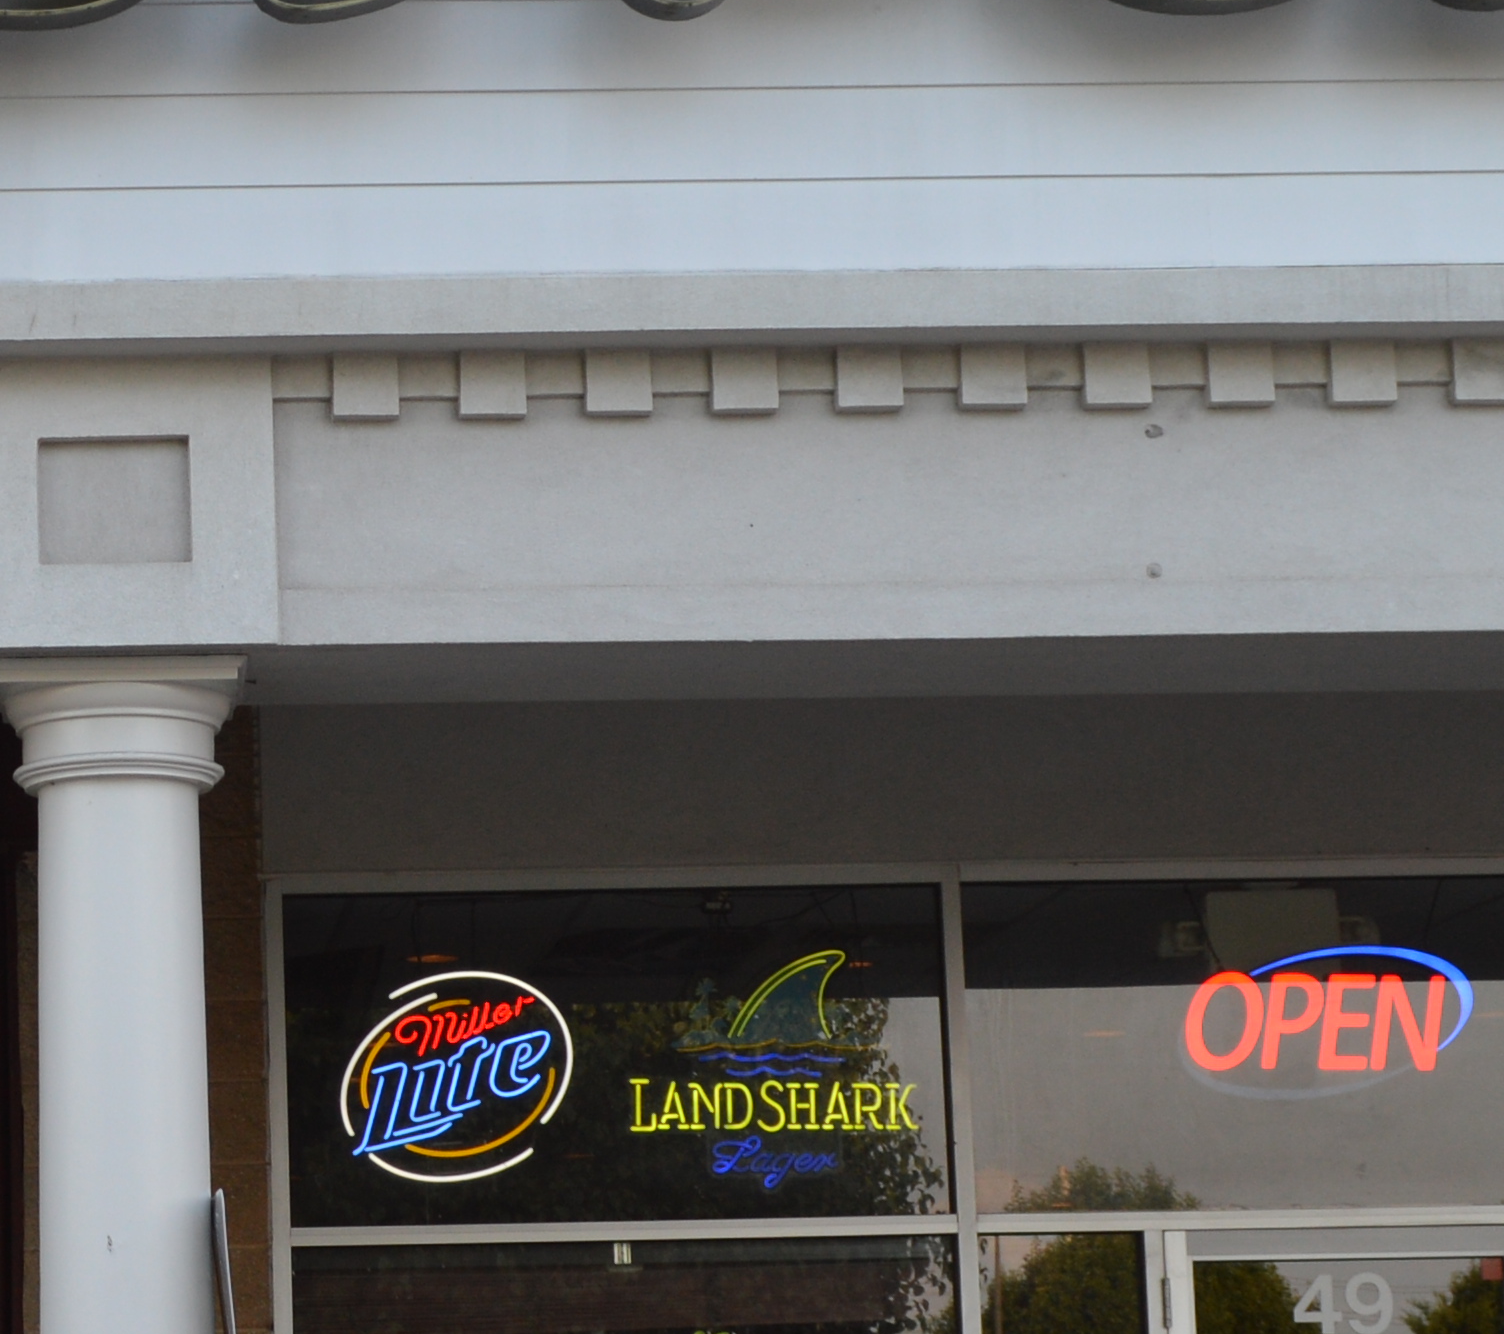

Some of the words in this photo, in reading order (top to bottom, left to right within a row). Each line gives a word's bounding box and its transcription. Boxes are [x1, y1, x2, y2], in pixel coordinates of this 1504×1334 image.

[394, 996, 535, 1056] Miller
[1184, 970, 1447, 1073] OPEN
[353, 1030, 550, 1155] Lite
[711, 1135, 838, 1189] Lager
